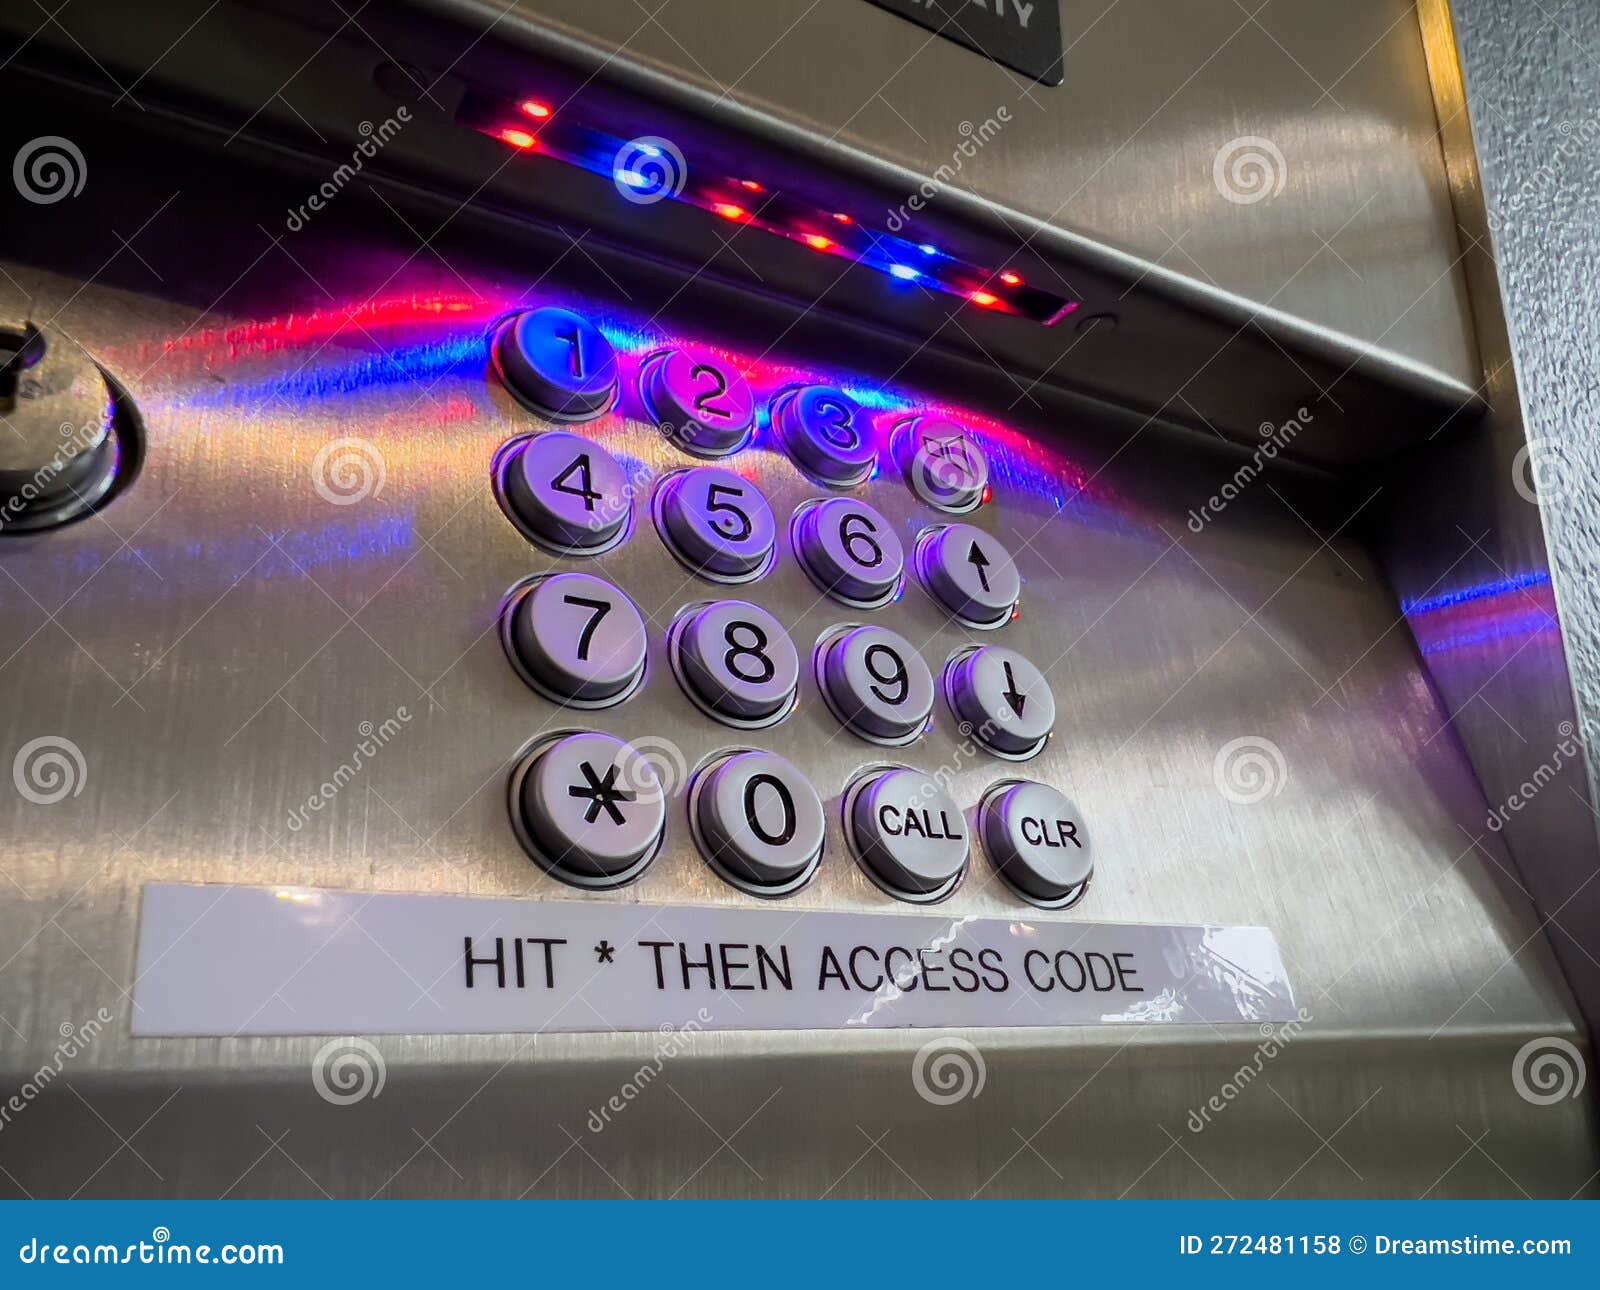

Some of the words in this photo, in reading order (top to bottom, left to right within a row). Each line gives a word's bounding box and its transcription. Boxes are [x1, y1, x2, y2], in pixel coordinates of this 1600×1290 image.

[555, 330, 583, 377] 1
[690, 364, 731, 417] 2
[817, 402, 858, 448] 3
[550, 453, 602, 512] 4
[706, 484, 752, 542] 5
[839, 513, 883, 568] 6
[563, 595, 612, 661] 7
[723, 620, 775, 684] 8
[863, 643, 909, 705] 9
[744, 773, 797, 846] 0
[879, 804, 963, 840] CALL
[1021, 816, 1082, 849] CLR
[464, 936, 567, 989] HIT
[638, 941, 793, 991] THEN
[818, 945, 1010, 993] ACCESS
[1023, 949, 1144, 993] CODE
